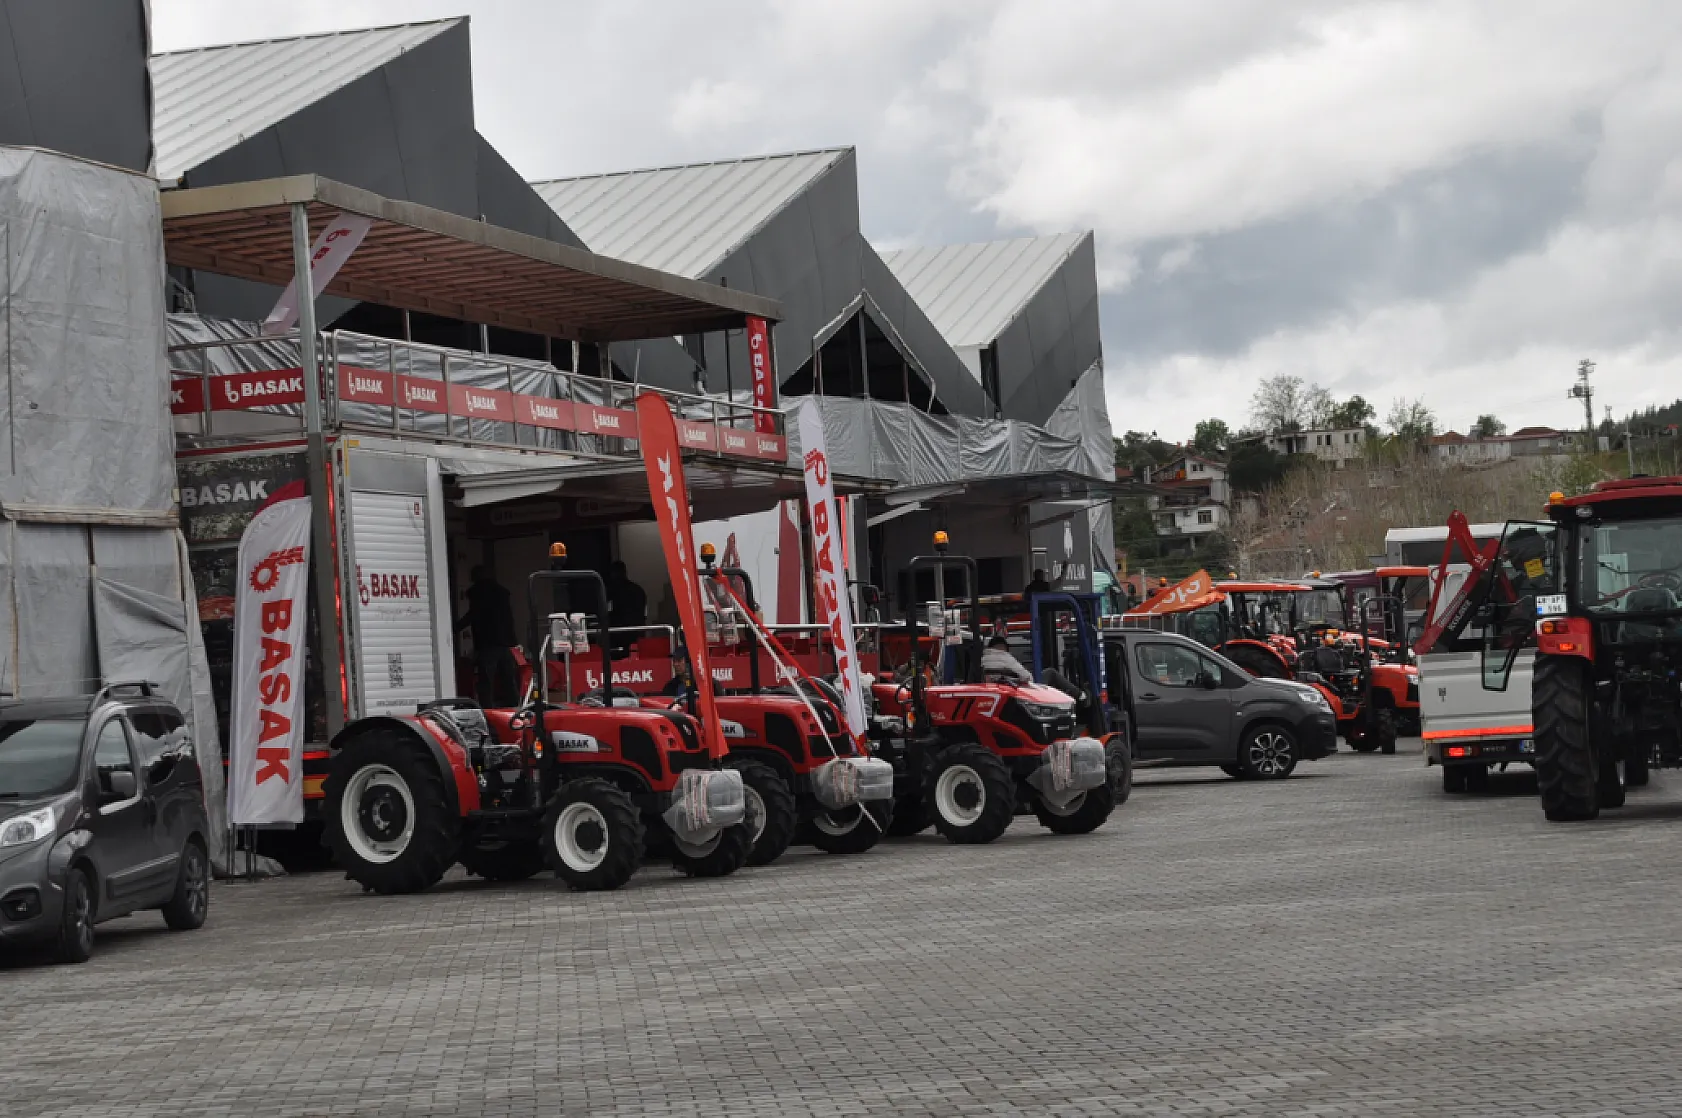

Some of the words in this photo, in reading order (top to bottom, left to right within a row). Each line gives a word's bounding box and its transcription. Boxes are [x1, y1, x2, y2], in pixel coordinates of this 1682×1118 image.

[241, 377, 302, 397] BASAK
[355, 379, 384, 395] BASAK
[411, 387, 437, 403] BASAK
[473, 396, 496, 411] BASAK
[536, 405, 559, 420] BASAK
[599, 415, 619, 428] BASAK
[181, 480, 268, 507] BASAK
[370, 573, 420, 599] BASAK
[255, 599, 293, 786] BASAK
[558, 739, 589, 750] BASAK
